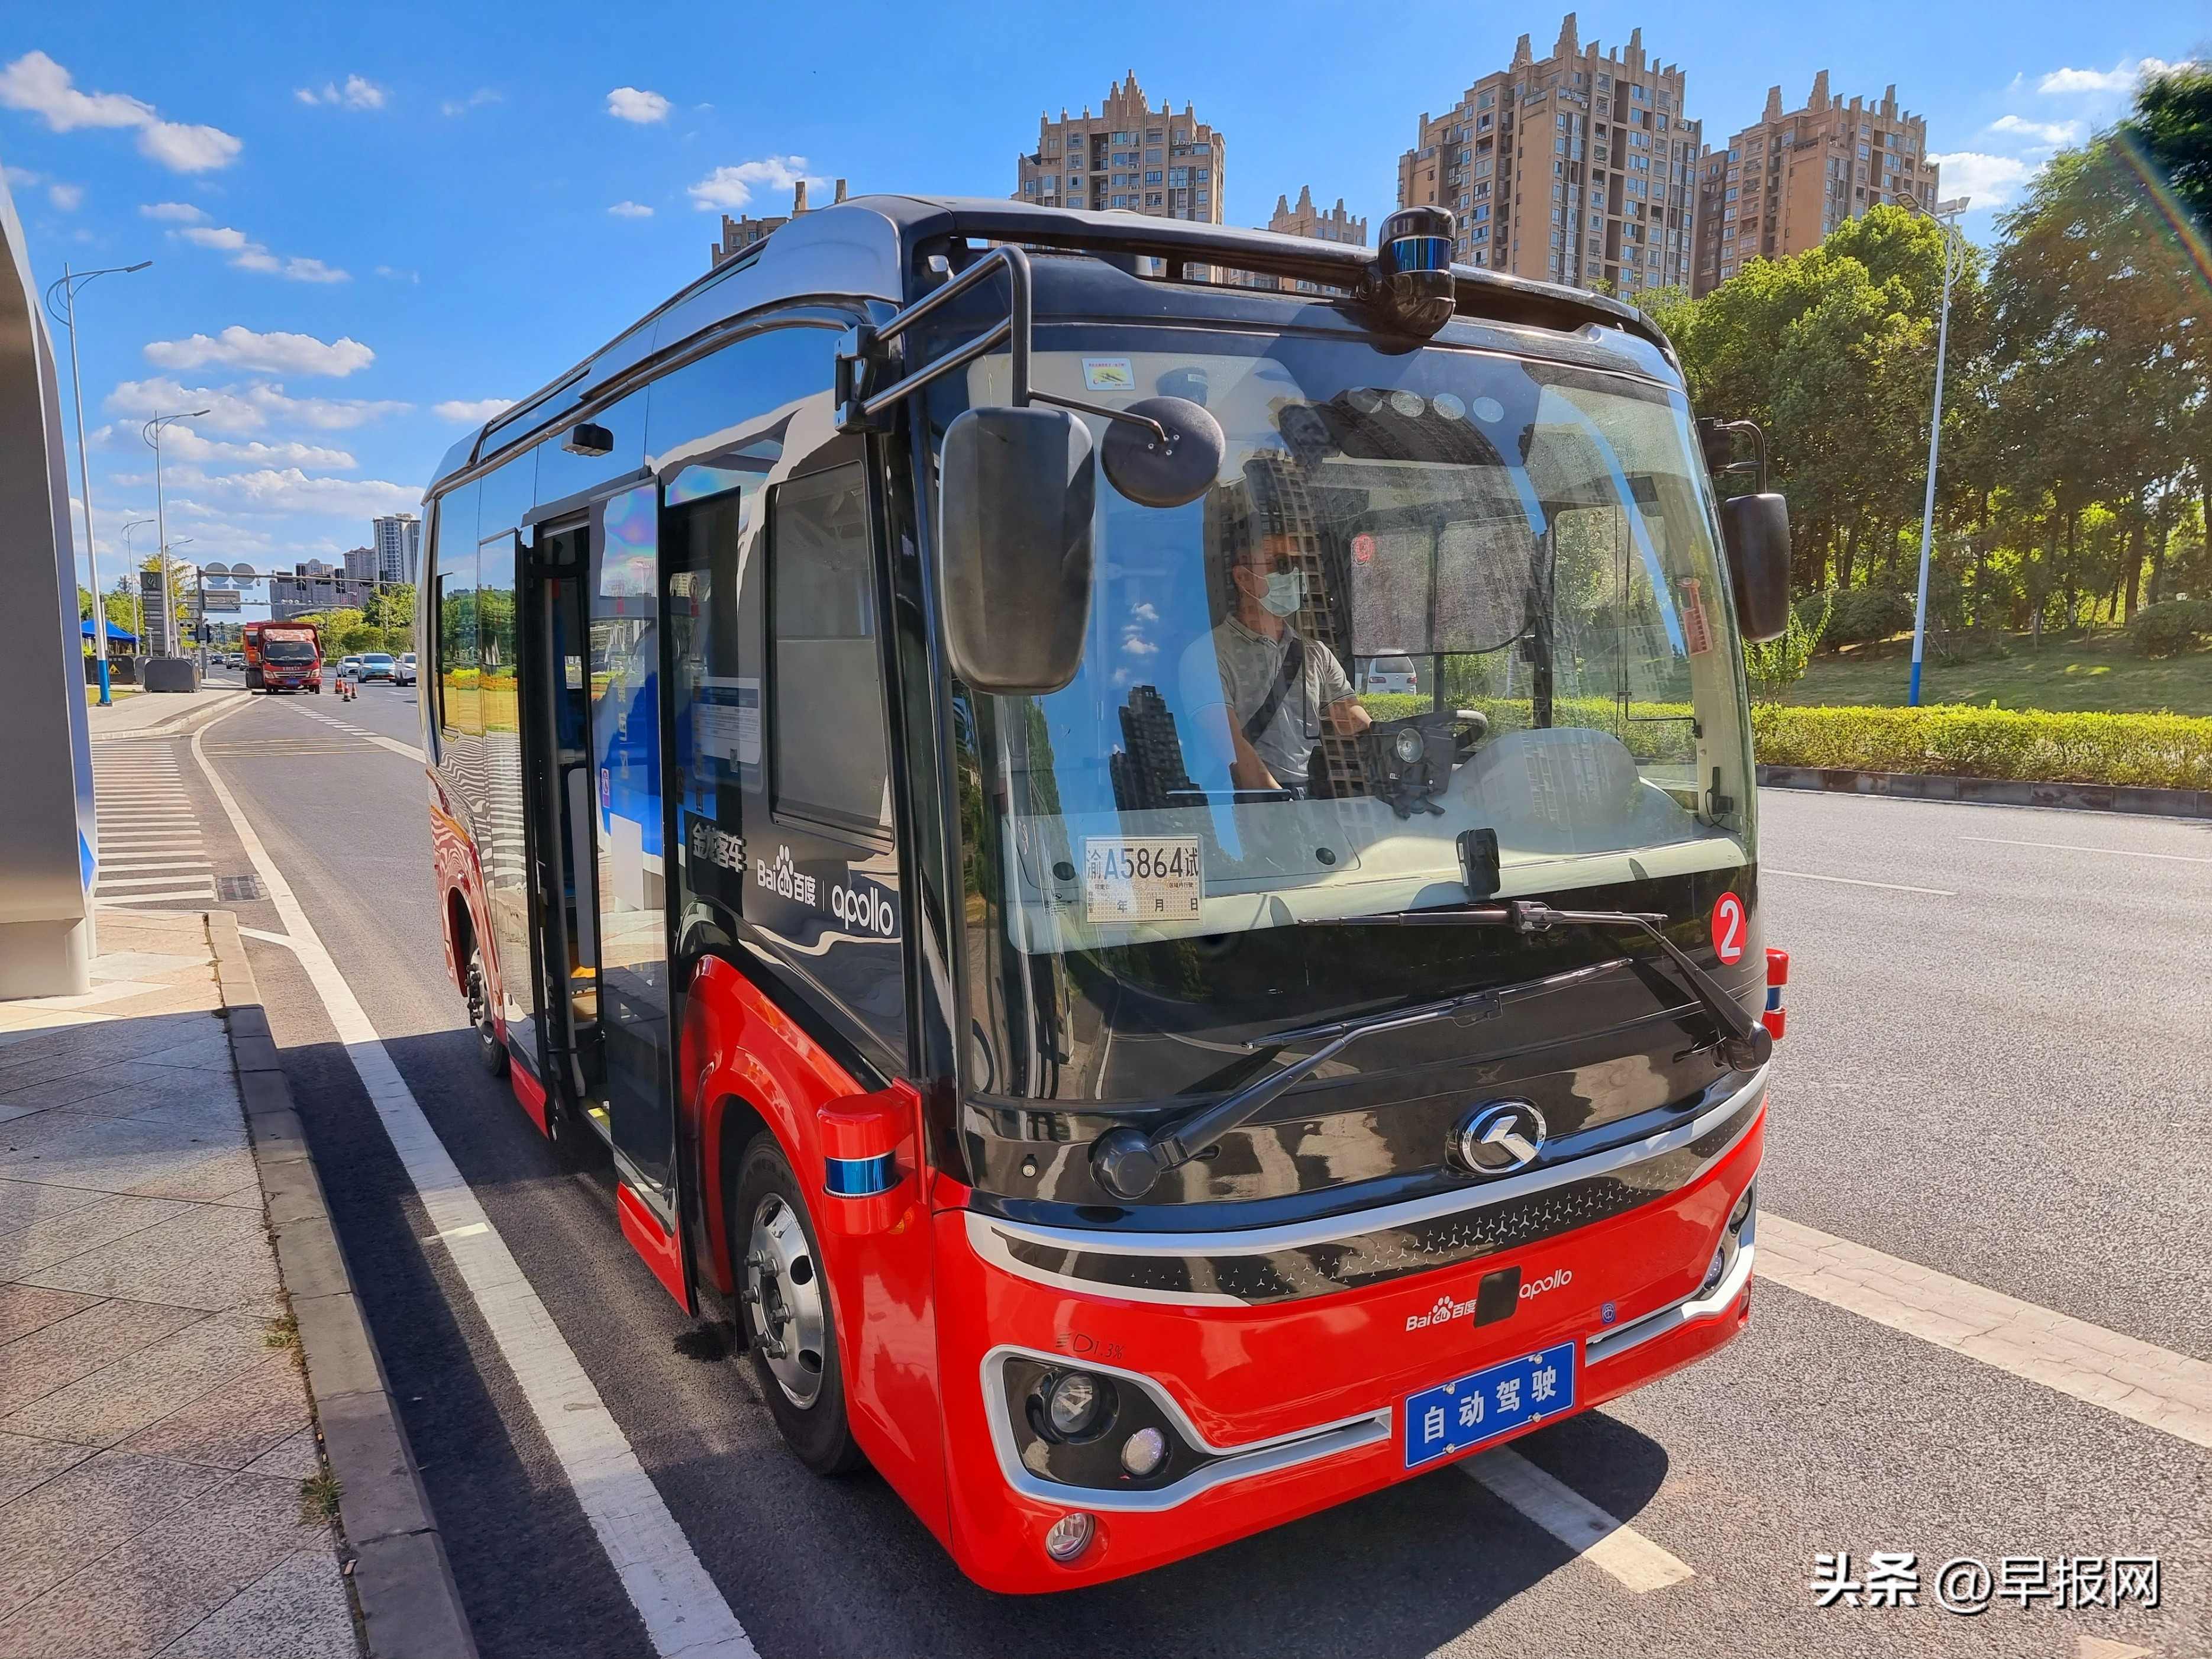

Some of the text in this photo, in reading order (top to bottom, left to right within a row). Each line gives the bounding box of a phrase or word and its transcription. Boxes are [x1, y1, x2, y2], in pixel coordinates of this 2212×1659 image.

[1087, 847, 1199, 880] 渝A5864试
[793, 872, 816, 907] 百度
[1155, 899, 1164, 912] 月
[1190, 898, 1199, 911] 日
[831, 884, 893, 935] apollo
[1720, 899, 1741, 958] 2
[1519, 1269, 1573, 1300] apollo
[1093, 1340, 1125, 1360] 1.3%
[1423, 1366, 1557, 1444] 自动驾驶
